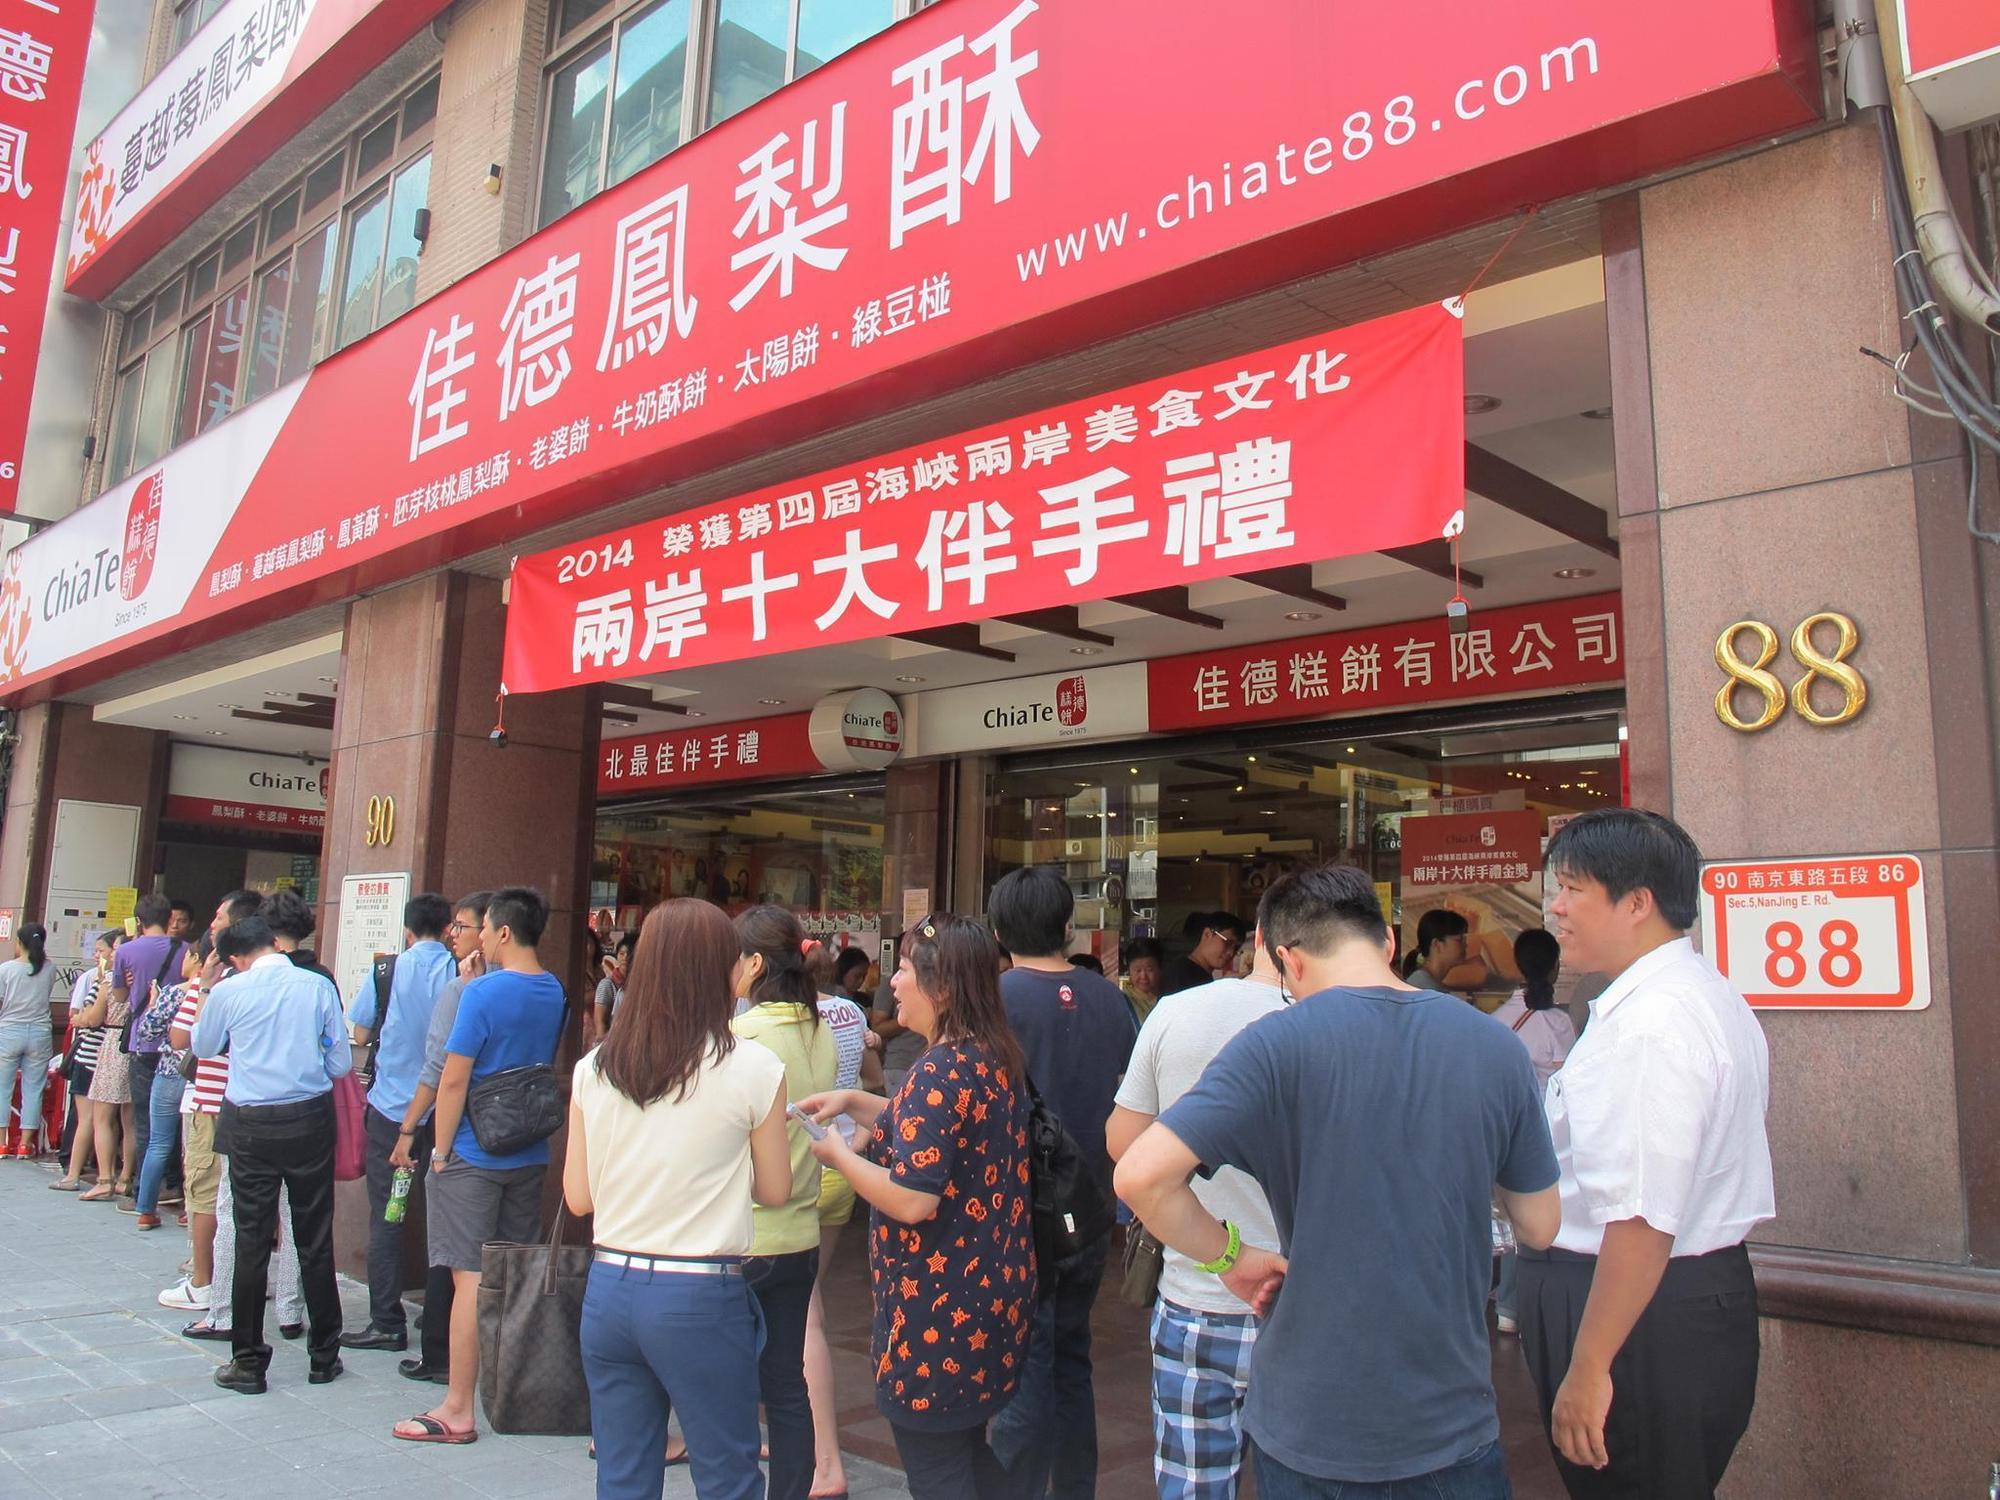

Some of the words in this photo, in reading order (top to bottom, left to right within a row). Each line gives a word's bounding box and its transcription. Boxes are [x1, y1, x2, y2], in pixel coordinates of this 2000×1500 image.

[1016, 35, 1600, 282] www.chiate88.com
[407, 0, 1042, 463] 佳德鳳梨酥
[529, 415, 590, 471] 老婆餅
[612, 368, 707, 437] 牛奶酥餅
[733, 323, 820, 393] 太陽餅
[851, 271, 952, 349] 綠豆椪
[557, 538, 635, 585] 2014
[662, 348, 1352, 559] 榮獲第四屆海峽兩岸美食文化
[43, 548, 120, 623] ChiaTe
[572, 436, 1296, 675] 兩岸十大伴手禮
[1192, 611, 1619, 713] 佳德糕餅有限公司
[1713, 611, 1869, 733] 88
[844, 713, 882, 728] ChiaTe
[983, 703, 1054, 729] ChiaTe
[249, 771, 317, 792] ChiaTe
[605, 730, 760, 780] 北最佳伴手禮
[366, 794, 395, 848] 90
[1714, 871, 1738, 890] 90
[1747, 866, 1869, 889] 南京東路五段
[1878, 863, 1905, 883] 86
[1814, 895, 1831, 906] Rd.
[1764, 919, 1863, 988] 88
